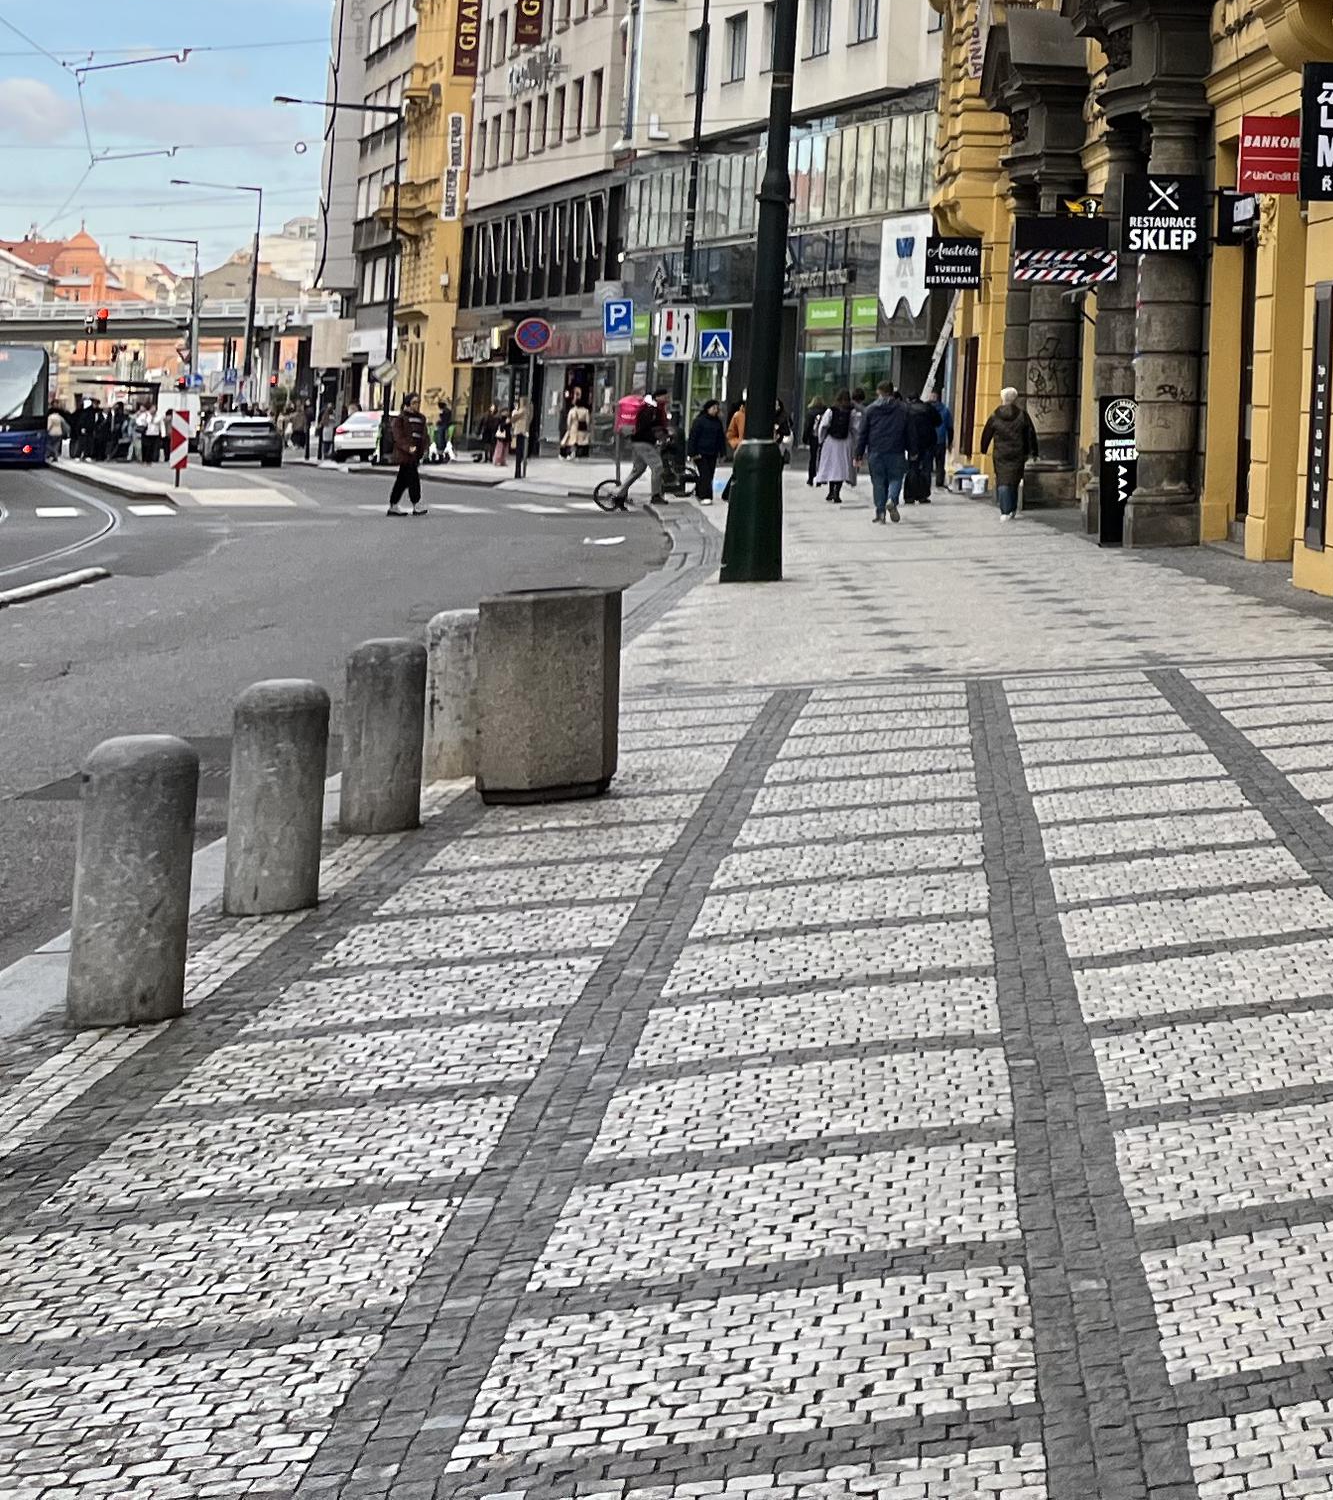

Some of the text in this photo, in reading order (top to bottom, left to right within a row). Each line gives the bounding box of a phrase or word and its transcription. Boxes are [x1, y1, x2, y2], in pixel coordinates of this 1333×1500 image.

[1252, 172, 1291, 181] UniCredit
[1130, 217, 1196, 228] RESTAURACE
[1128, 229, 1197, 251] SKLEP
[927, 243, 979, 260] Anatolia
[934, 265, 971, 273] TURKISH
[926, 276, 979, 284] RESTAURANT
